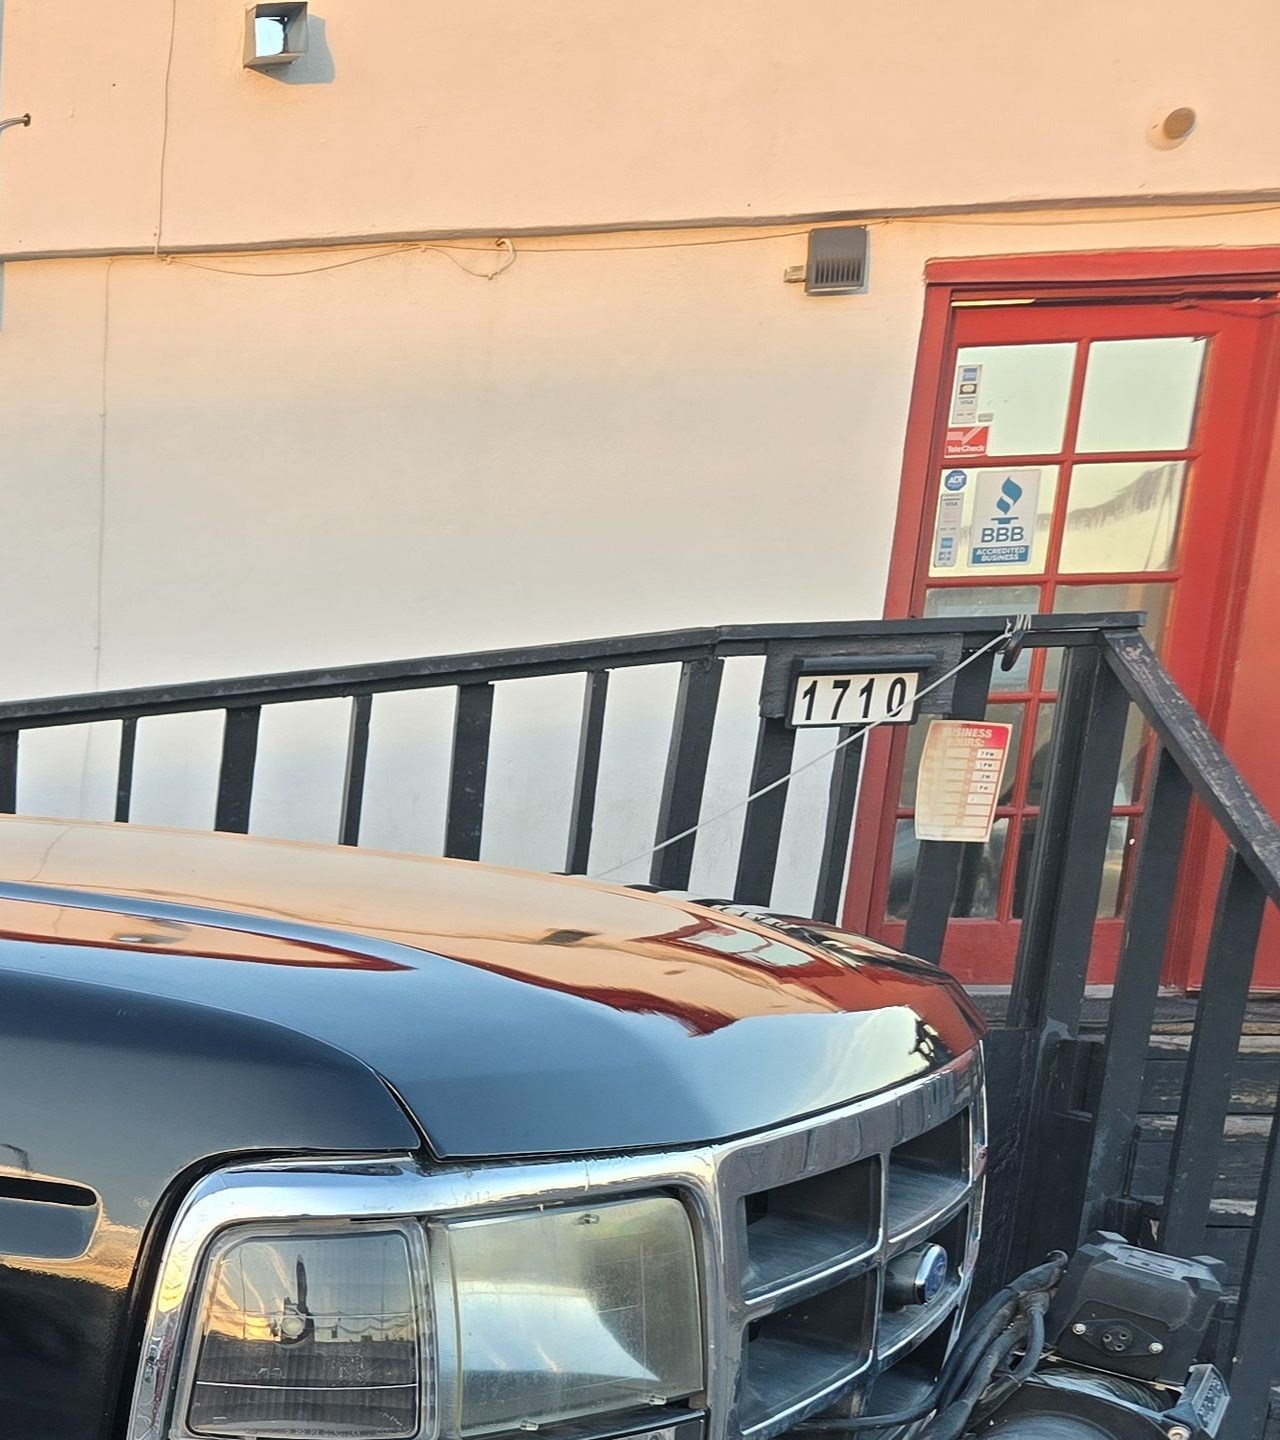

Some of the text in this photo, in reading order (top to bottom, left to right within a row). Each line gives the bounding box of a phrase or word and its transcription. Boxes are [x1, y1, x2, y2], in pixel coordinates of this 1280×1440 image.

[981, 526, 1025, 543] BBB
[976, 547, 1026, 556] ACCREDITED
[981, 554, 1019, 562] BUSINESS
[802, 677, 907, 720] 1710
